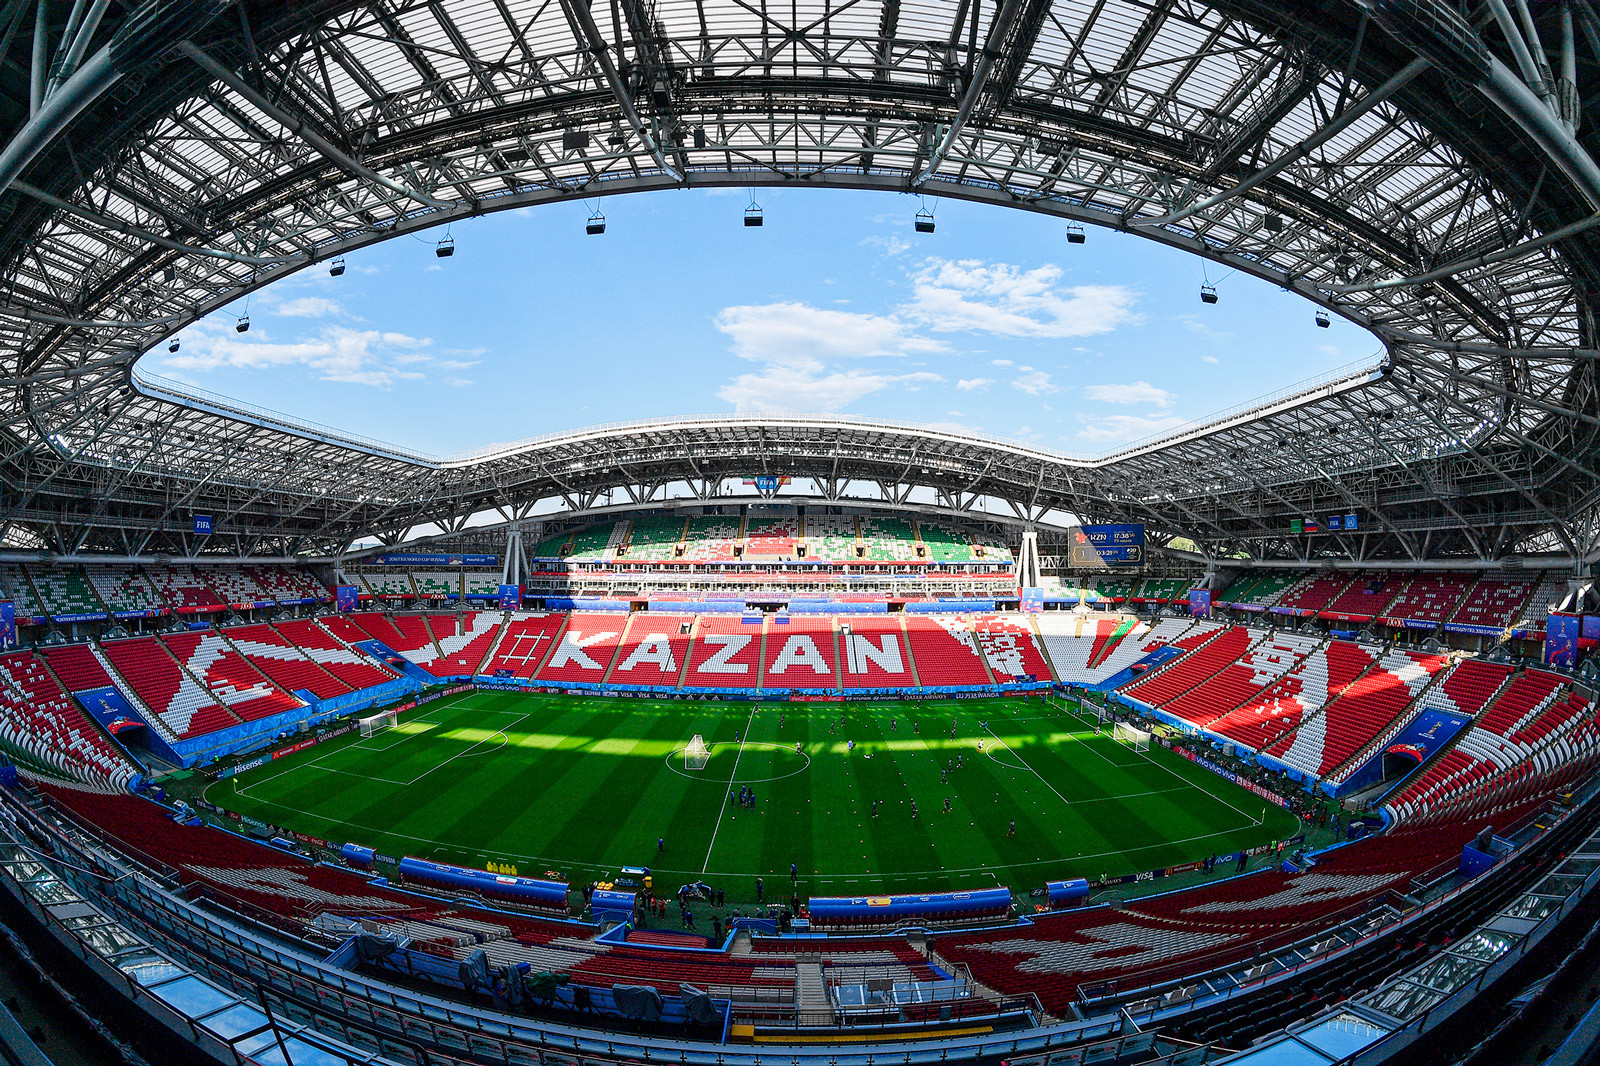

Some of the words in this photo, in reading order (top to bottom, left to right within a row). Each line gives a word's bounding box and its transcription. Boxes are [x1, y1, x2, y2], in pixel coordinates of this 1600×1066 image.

[234, 758, 262, 774] Hisense
[1196, 757, 1208, 768] vivo
[1209, 763, 1222, 774] vivo
[1222, 769, 1236, 780] vivo
[1136, 872, 1154, 880] VISA
